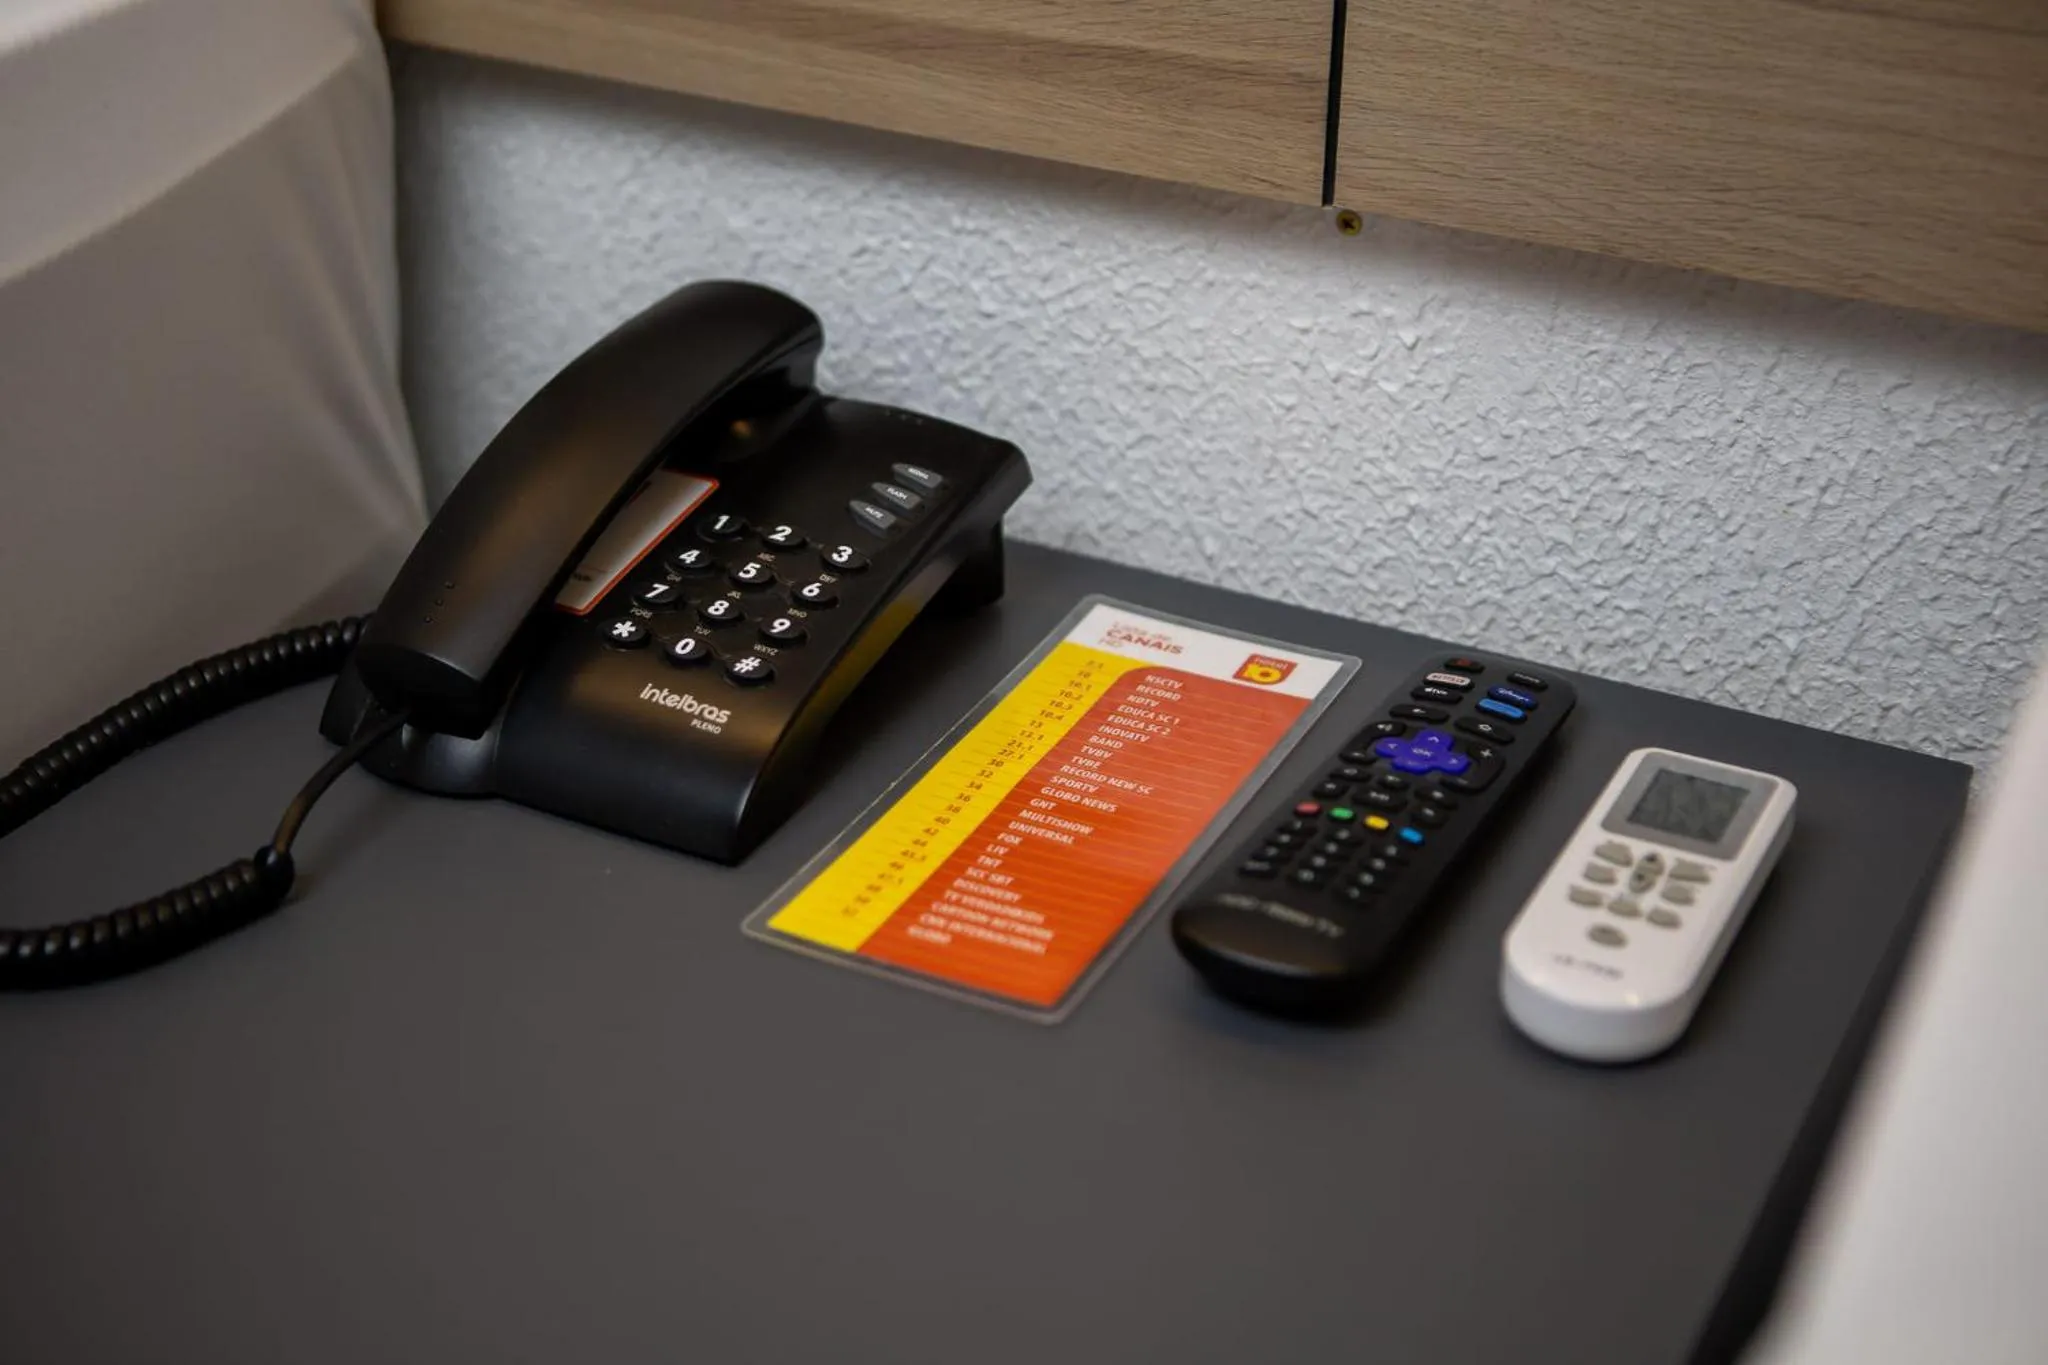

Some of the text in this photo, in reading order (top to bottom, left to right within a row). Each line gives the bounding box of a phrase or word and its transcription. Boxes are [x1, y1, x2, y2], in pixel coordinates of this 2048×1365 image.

[713, 515, 853, 563] 1 2 3
[678, 549, 823, 597] 4 5 6
[645, 583, 792, 633] 7 8 9
[1106, 628, 1184, 654] CANAIS
[675, 638, 696, 655] 0
[733, 656, 762, 673] #
[1135, 684, 1182, 702] RECORD
[639, 683, 731, 724] intelbras
[1107, 714, 1146, 730] EDUCA
[1146, 723, 1163, 734] SC
[1117, 704, 1157, 720] EDUCA
[1155, 713, 1173, 724] SC
[690, 718, 722, 735] PLENO
[1098, 725, 1150, 743] INOVATV
[1088, 735, 1124, 750] BAND
[987, 758, 1005, 768] 30
[976, 769, 994, 779] 32
[1050, 775, 1100, 793] SPORTV
[1060, 765, 1155, 796] RECORD NEW SC
[966, 781, 984, 791] 34
[1029, 798, 1057, 811] GNT
[1040, 786, 1118, 813] GLOBO NEWS
[1008, 820, 1076, 845] UNIVERSAL
[1018, 809, 1094, 836] MULTISHOW
